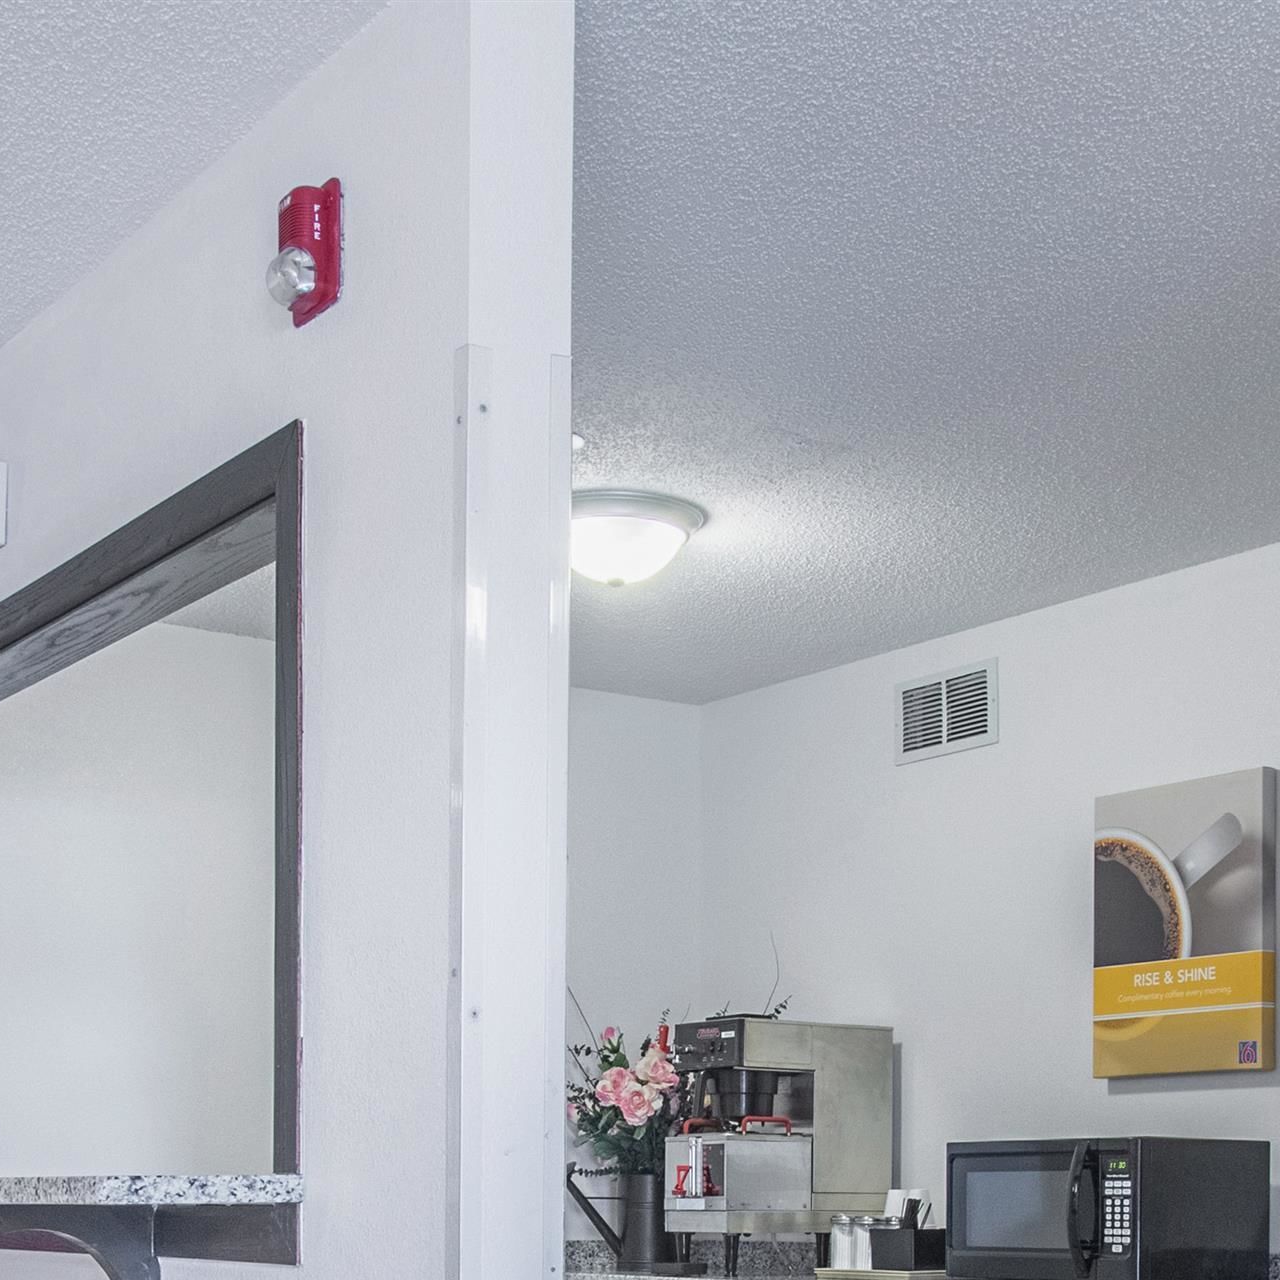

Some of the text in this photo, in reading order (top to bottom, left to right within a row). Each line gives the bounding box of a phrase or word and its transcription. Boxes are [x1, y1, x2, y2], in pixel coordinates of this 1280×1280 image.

[313, 204, 321, 240] FIRE
[1134, 966, 1216, 987] RISE & SHINE
